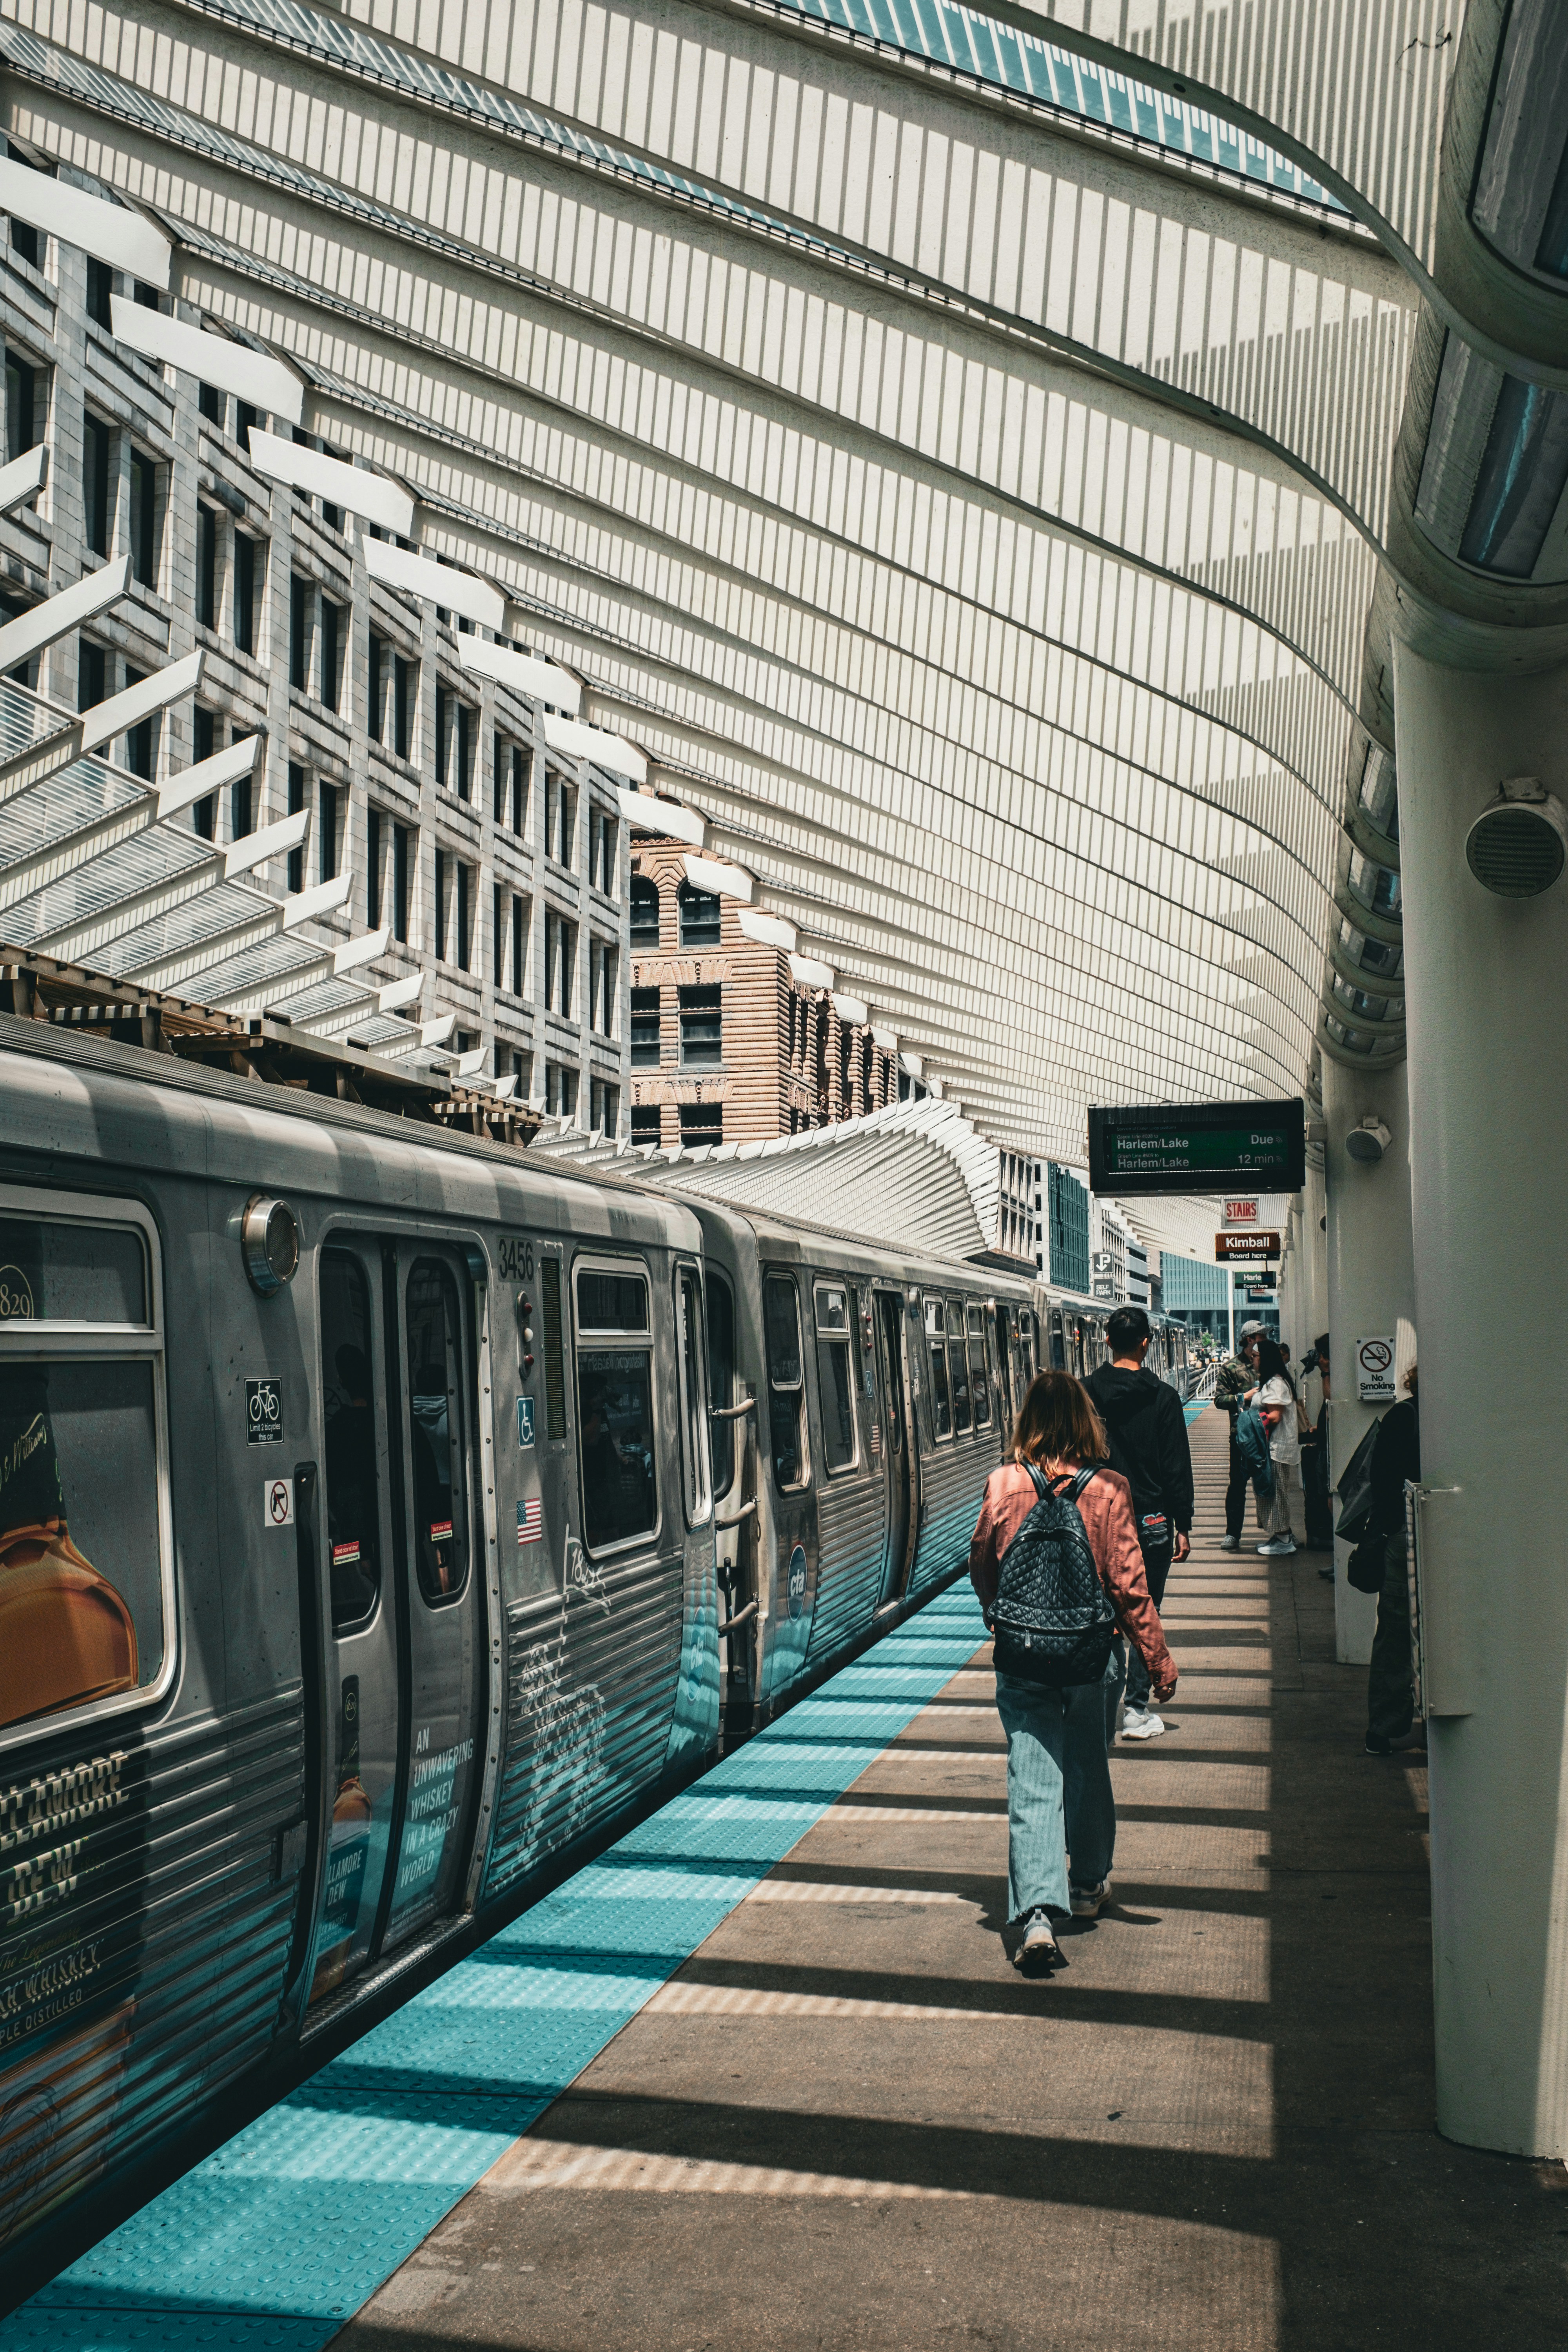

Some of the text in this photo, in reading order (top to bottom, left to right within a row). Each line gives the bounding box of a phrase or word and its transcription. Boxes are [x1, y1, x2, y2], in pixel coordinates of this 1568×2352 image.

[1117, 1134, 1274, 1149] Harlem/Lake Due
[1118, 1154, 1274, 1168] Harlem/Lake 12 min
[1226, 1202, 1257, 1218] STAIRS
[1226, 1236, 1270, 1248] Kimball
[499, 1238, 534, 1281] 3456
[1360, 1382, 1396, 1391] Smoking
[250, 1423, 261, 1432] Limit
[265, 1422, 281, 1432] bicycles
[790, 1569, 805, 1596] cta
[690, 1636, 704, 1670] cta
[346, 1699, 357, 1712] 1829
[416, 1727, 430, 1755] AN
[414, 1738, 474, 1788] UNWAVERING
[410, 1778, 454, 1822] WHISKEY
[405, 1805, 459, 1856] IN A CRAZY
[7, 1838, 82, 1926] DEW
[400, 1849, 435, 1889] WORLD
[327, 1878, 348, 1907] DEW
[24, 1938, 105, 2004] WHISKEY
[25, 1988, 82, 2031] DISTILLED
